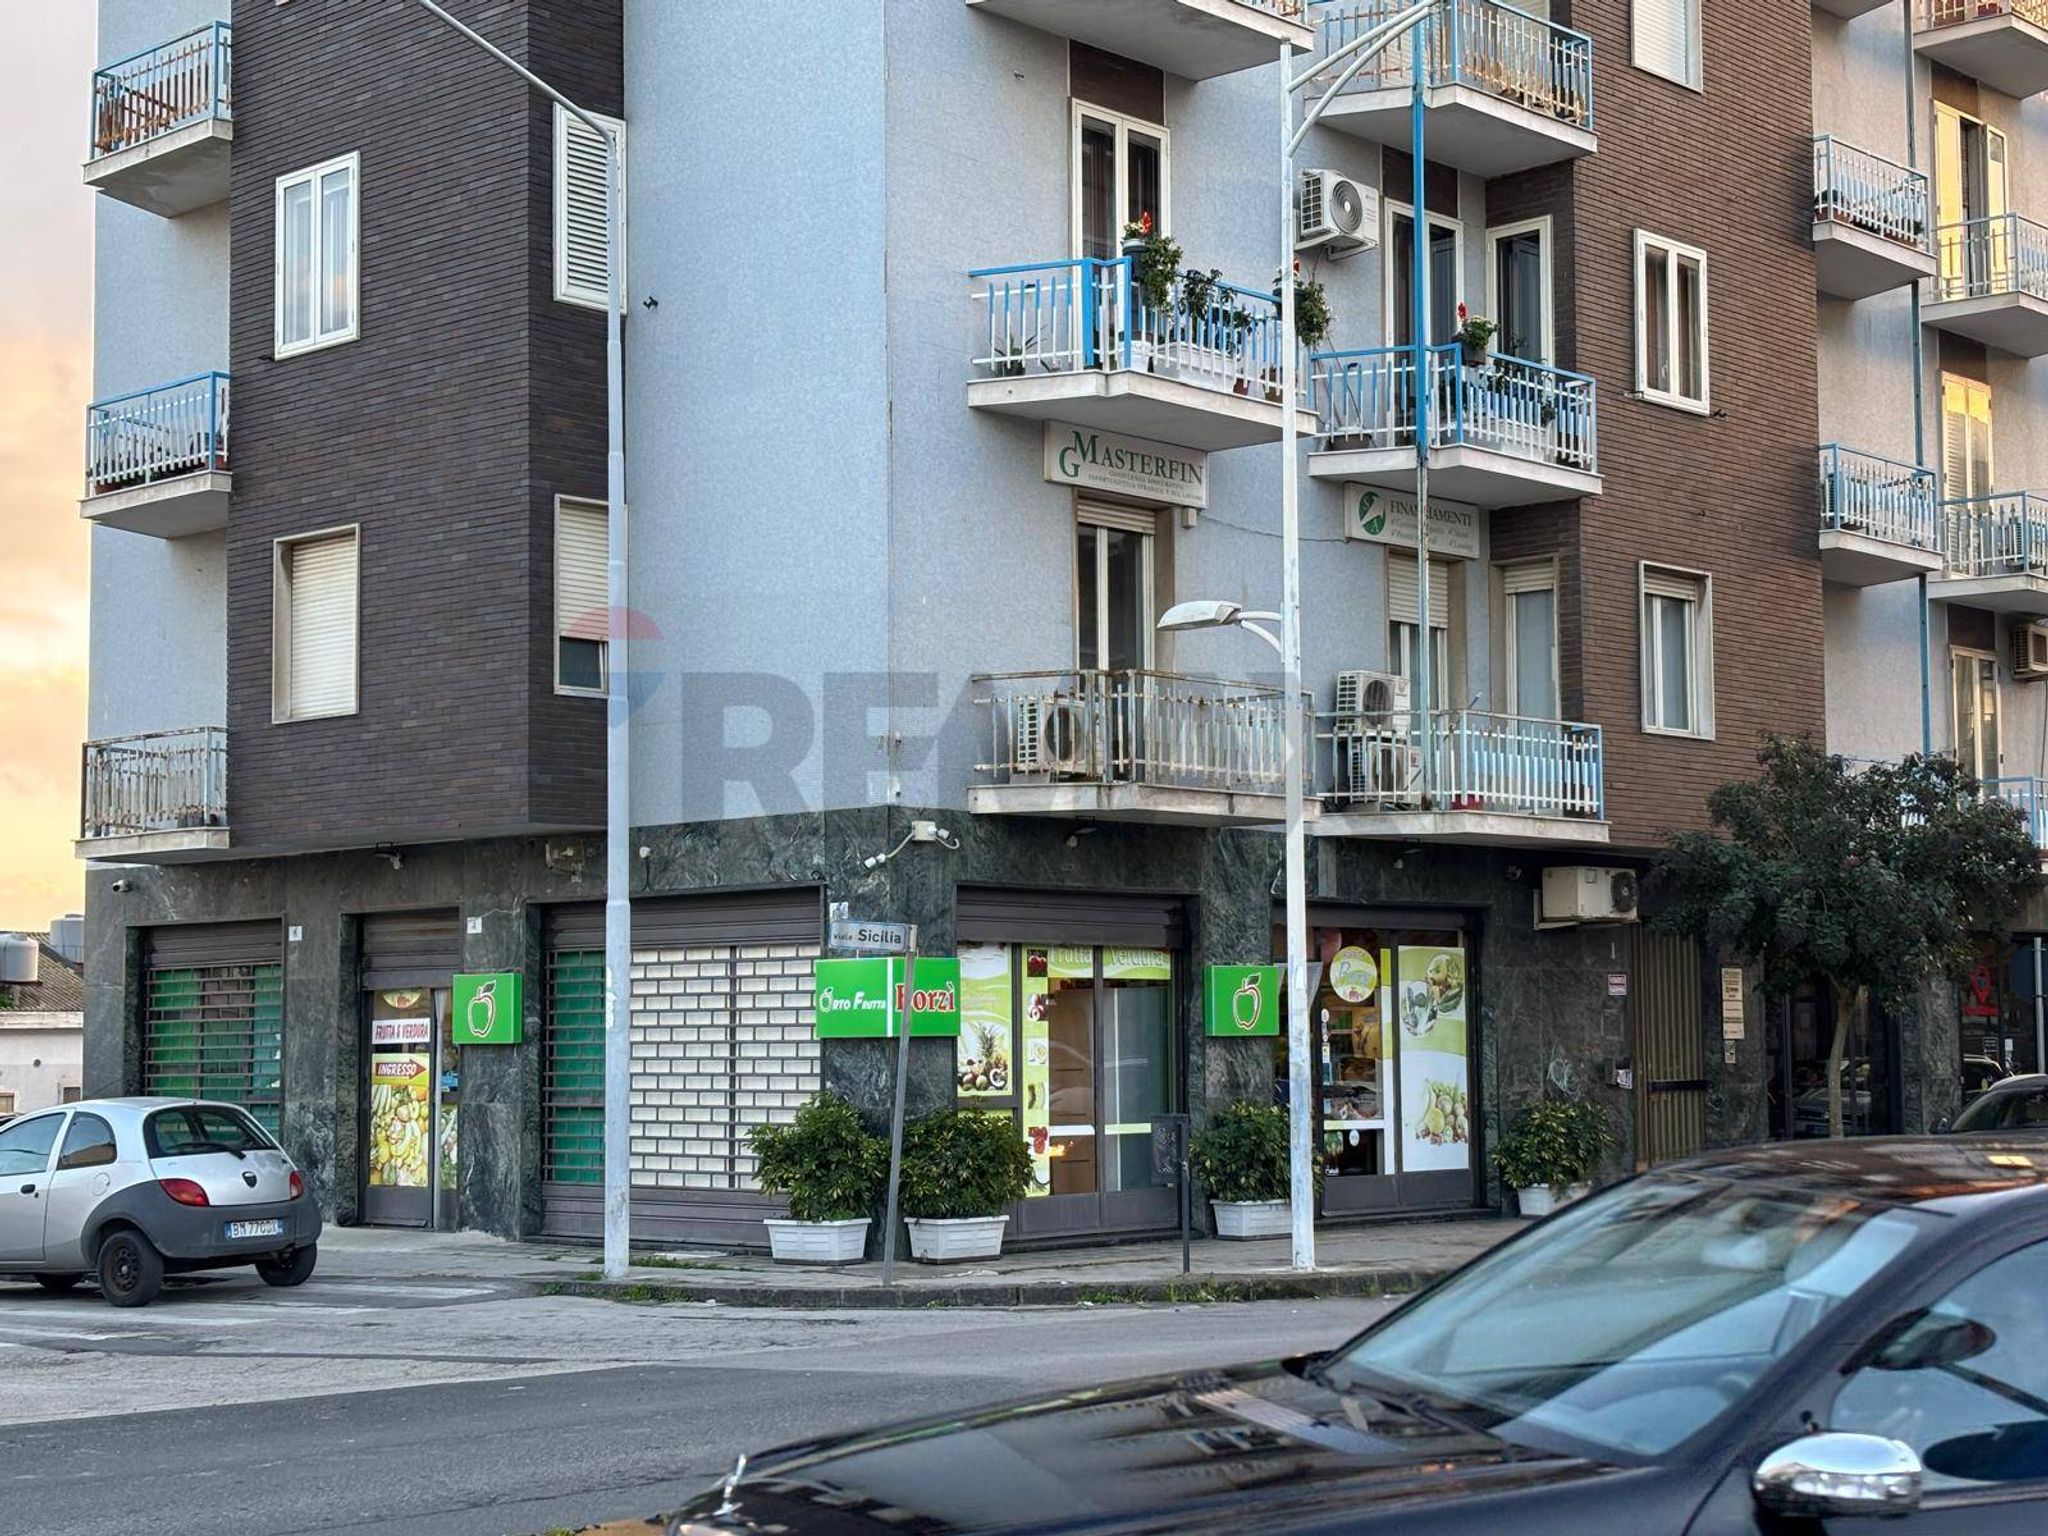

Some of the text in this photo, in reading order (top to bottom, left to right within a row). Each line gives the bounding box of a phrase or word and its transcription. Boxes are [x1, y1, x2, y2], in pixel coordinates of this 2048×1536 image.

[1072, 430, 1204, 486] MASTERFIN
[1391, 500, 1472, 527] FINAIAMENTI
[834, 929, 901, 944] viale Sicilia
[375, 1024, 395, 1040] FRUTTA
[402, 1022, 428, 1039] VERDURA
[378, 1063, 417, 1076] INGRESSO
